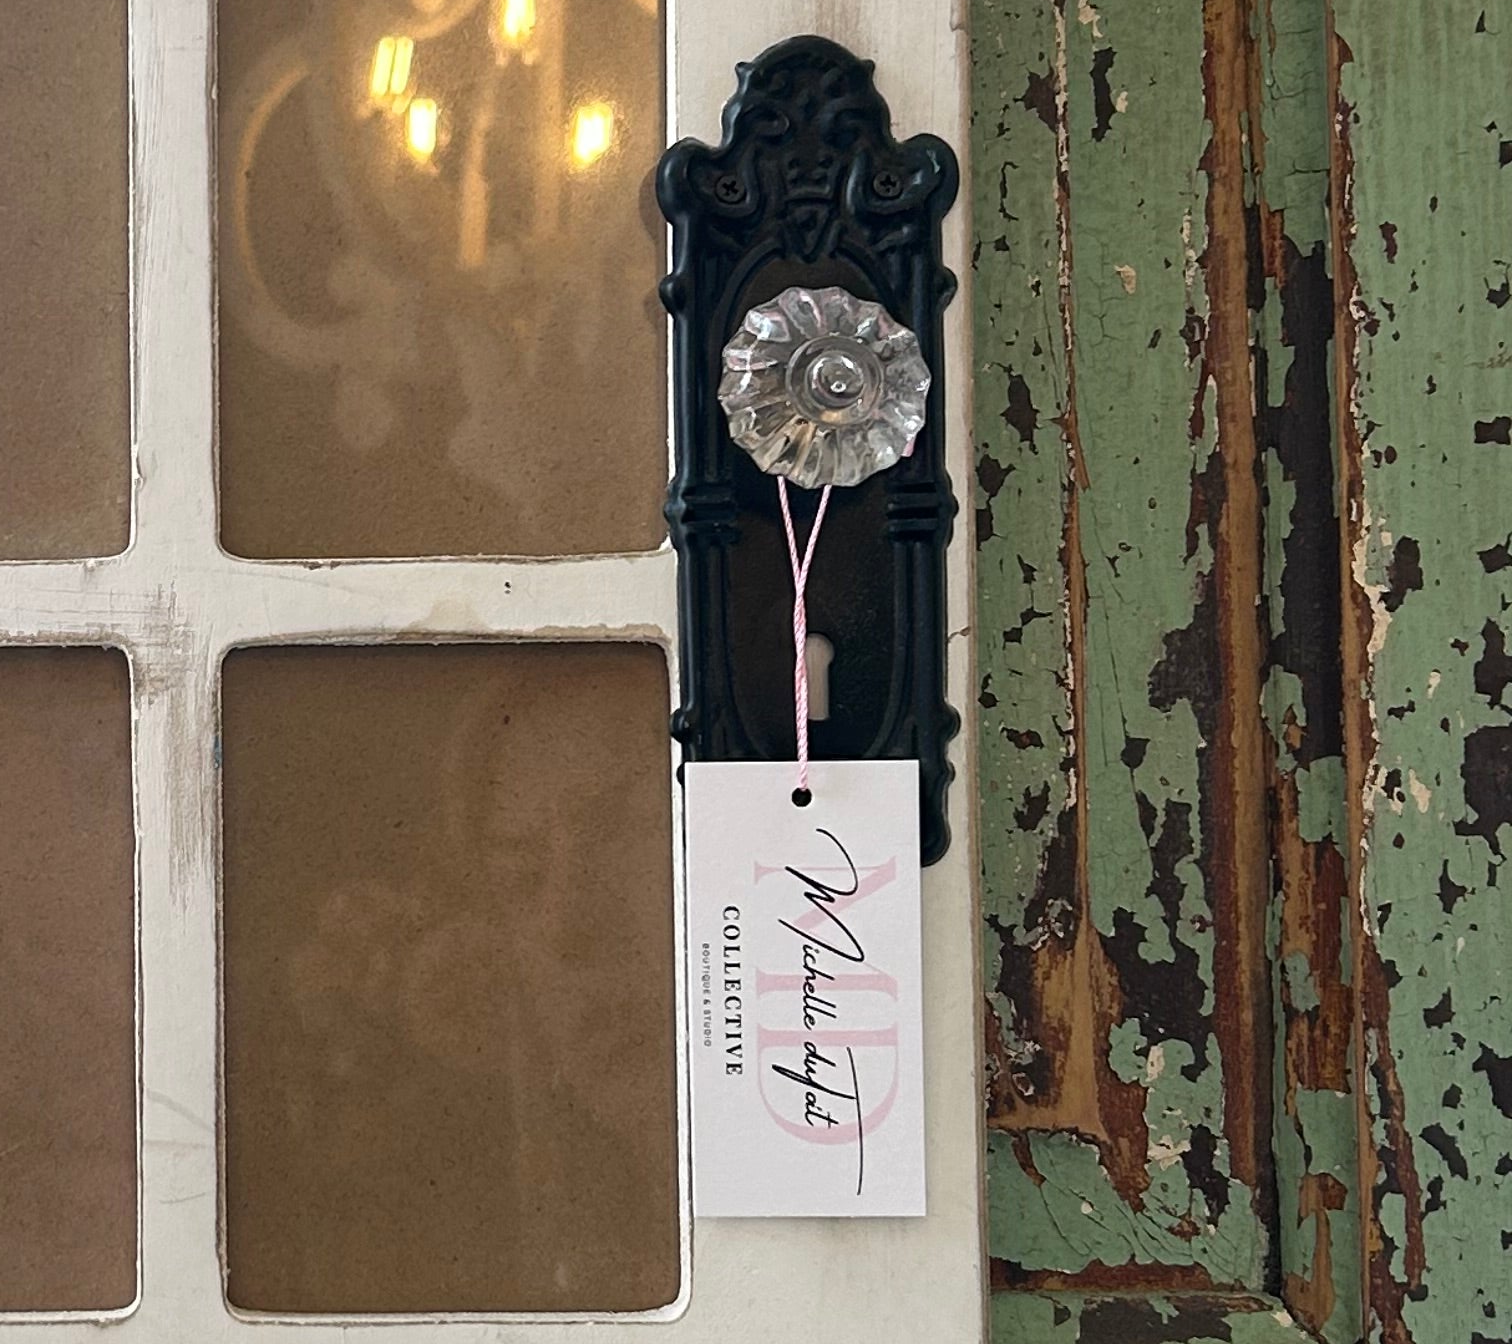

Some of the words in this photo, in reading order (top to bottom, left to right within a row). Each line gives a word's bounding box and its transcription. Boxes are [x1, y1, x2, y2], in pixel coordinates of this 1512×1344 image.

[701, 942, 711, 995] BOUTIQUE
[778, 828, 864, 1033] Michelle
[703, 998, 711, 1006] &
[703, 1009, 712, 1047] STUDIO
[722, 905, 744, 1076] COLLECTIVE
[754, 856, 899, 1146] MD
